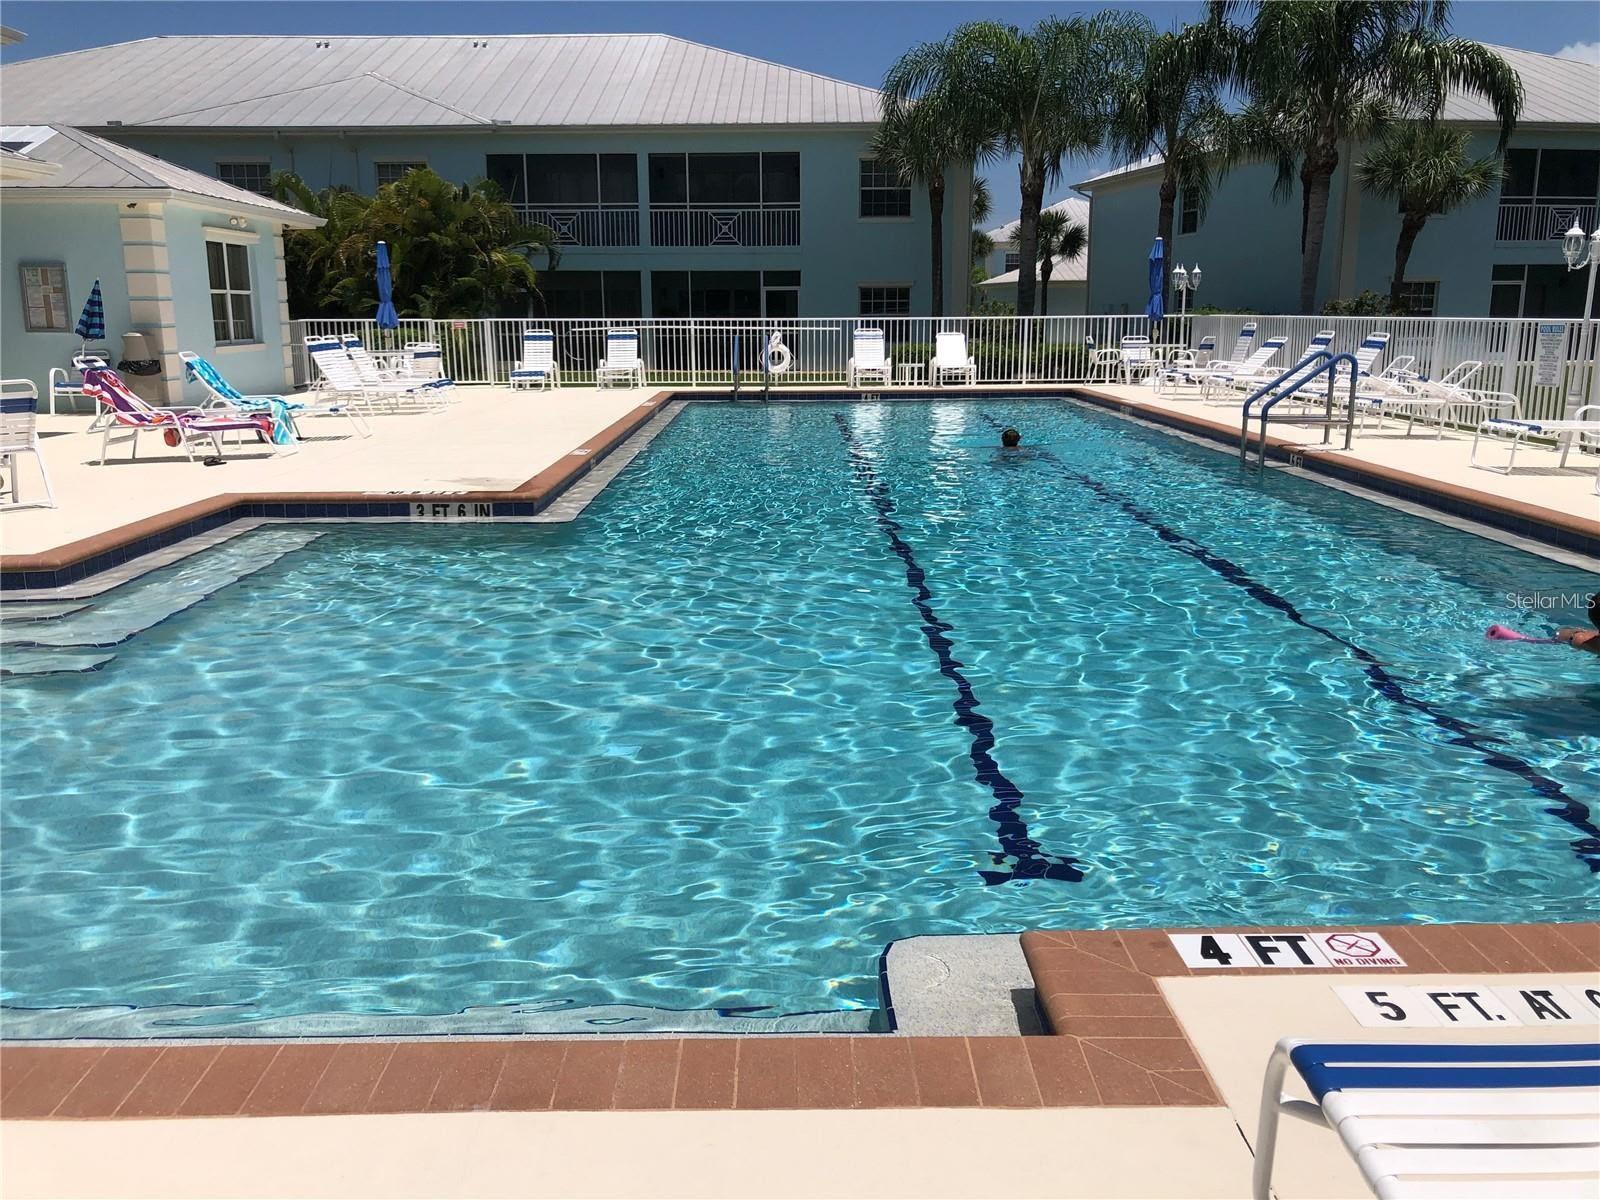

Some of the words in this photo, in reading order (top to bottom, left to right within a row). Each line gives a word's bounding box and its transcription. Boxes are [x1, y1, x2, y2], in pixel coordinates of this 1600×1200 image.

[416, 503, 424, 516] 3
[432, 504, 450, 517] FT
[458, 503, 466, 517] 6
[474, 504, 490, 517] IN
[1200, 935, 1232, 965] 4
[1244, 935, 1314, 965] FT
[1365, 991, 1407, 1021] 5
[1426, 992, 1506, 1022] FT.
[1519, 990, 1572, 1020] AT
